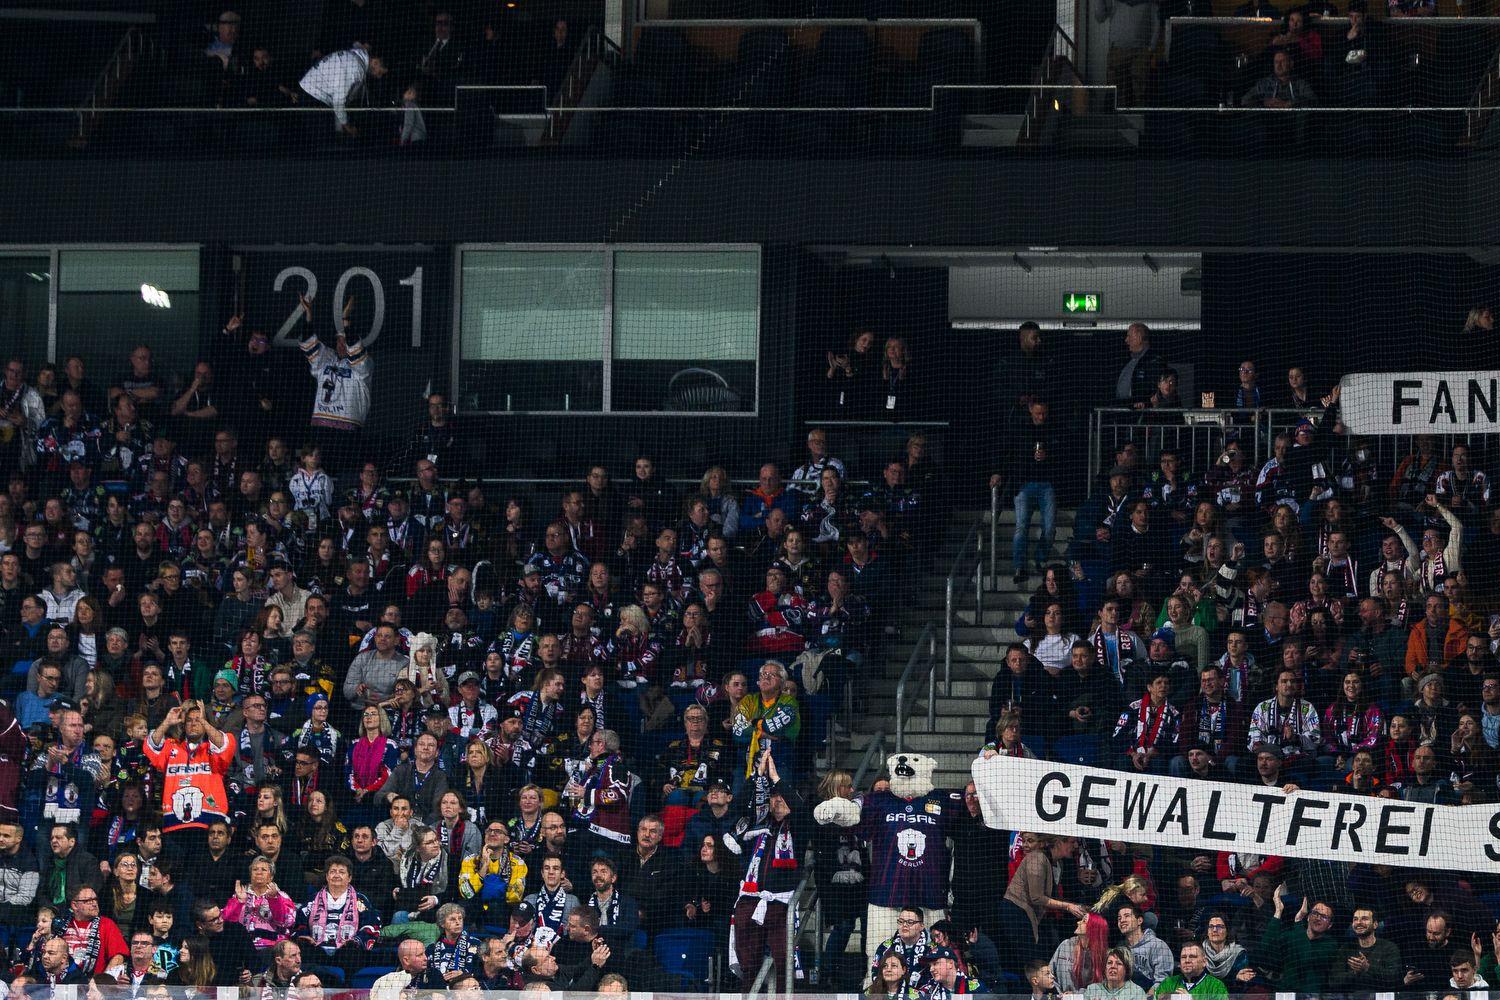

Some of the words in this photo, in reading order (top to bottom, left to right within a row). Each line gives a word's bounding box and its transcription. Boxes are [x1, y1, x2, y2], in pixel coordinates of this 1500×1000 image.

[273, 266, 424, 348] 201
[1035, 771, 1434, 856] GEWALTFREI
[898, 858, 924, 868] BERLIN
